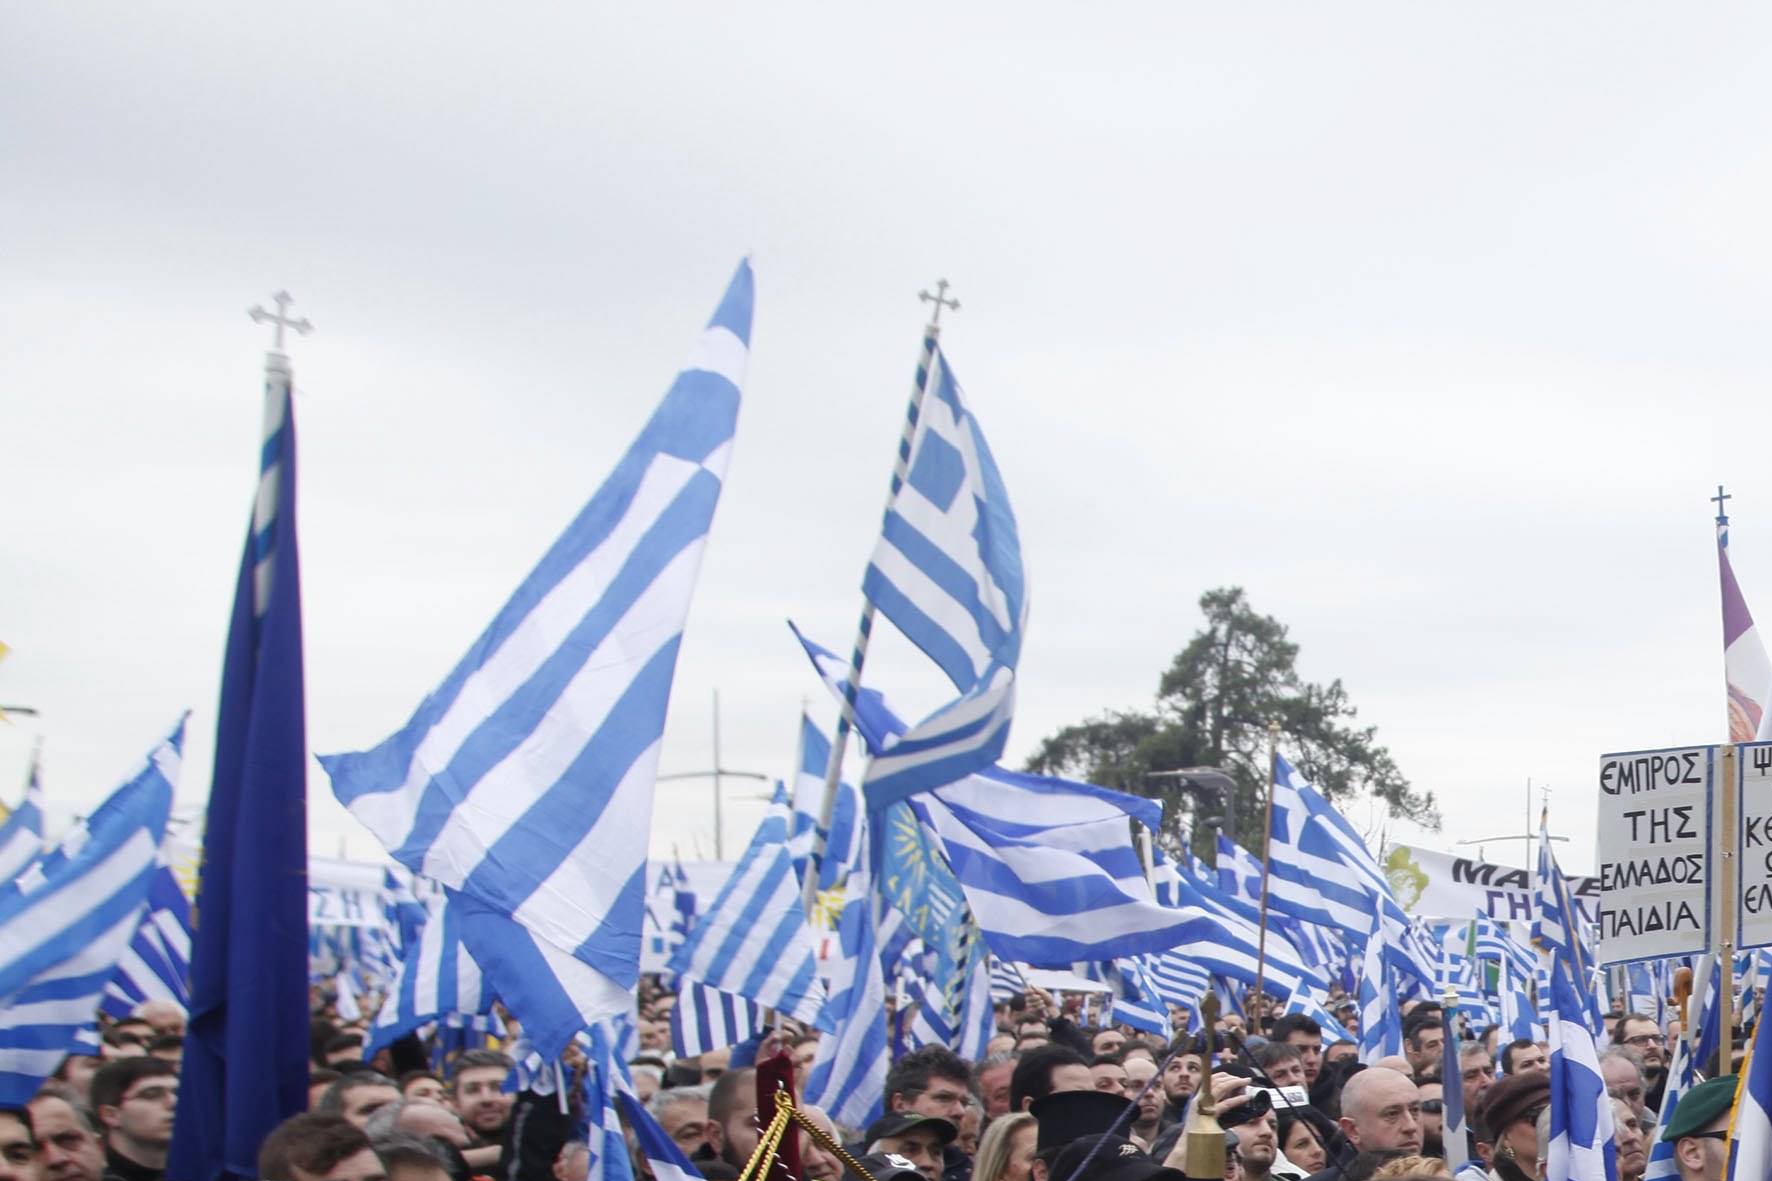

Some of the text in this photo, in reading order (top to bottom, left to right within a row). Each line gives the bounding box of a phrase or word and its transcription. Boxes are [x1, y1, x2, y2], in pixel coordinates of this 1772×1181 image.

[1600, 752, 1701, 795] ΕΜΠΡΟΣ
[1624, 806, 1698, 843] ΤΗΣ
[1601, 854, 1703, 891] ΕΛΛΑΔΟΣ
[1600, 901, 1701, 940] ΠΑΙΔΙΑ
